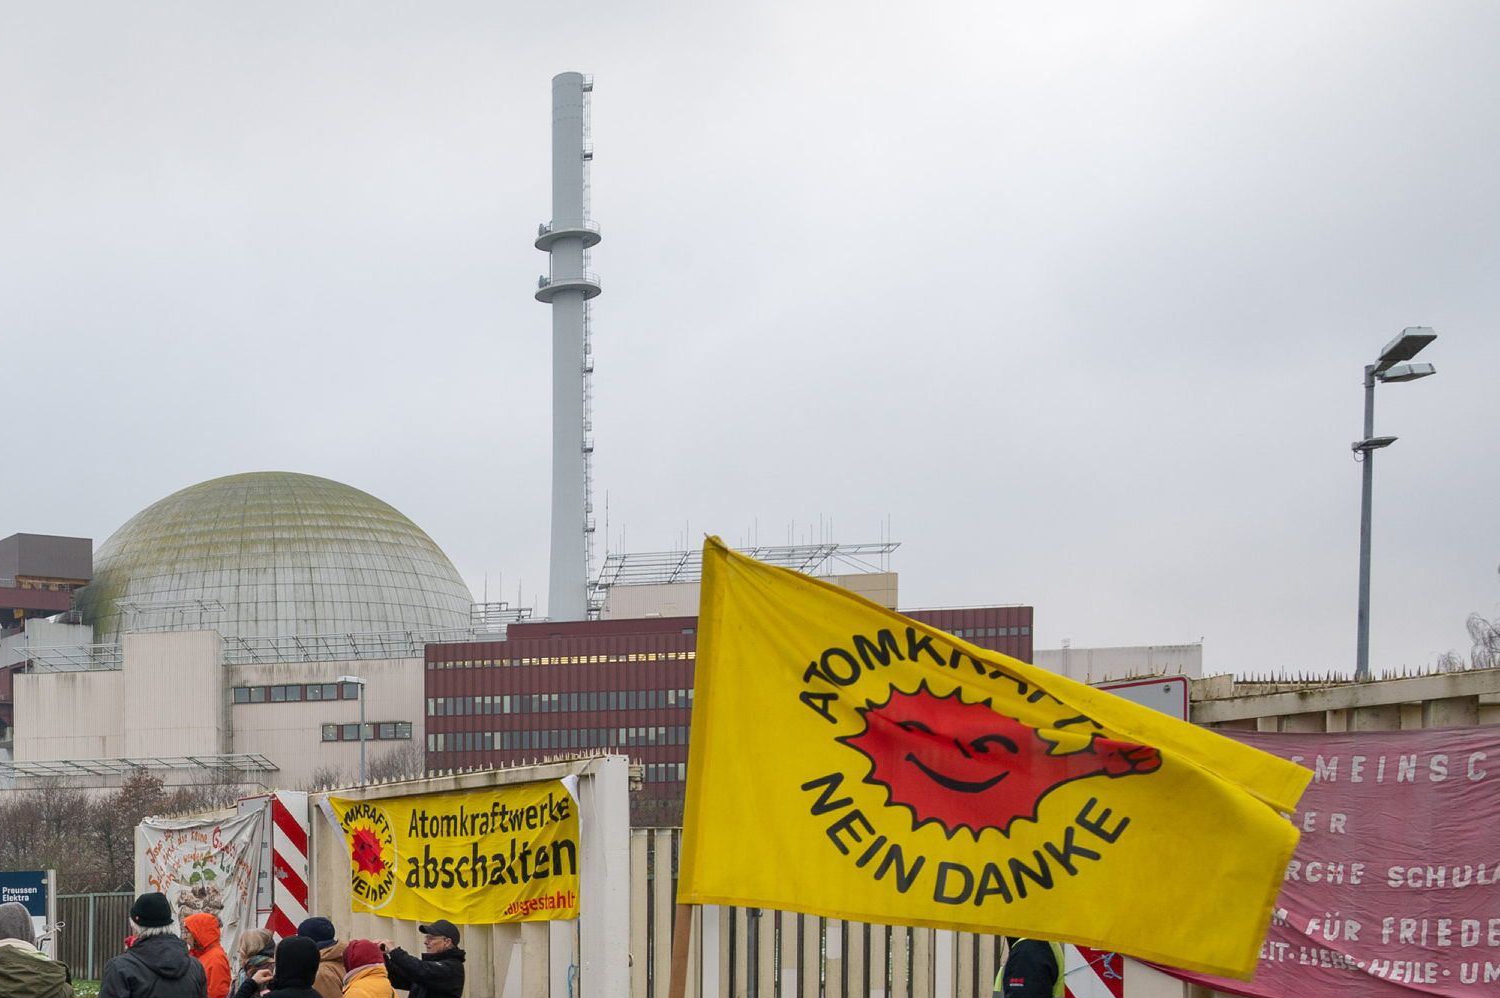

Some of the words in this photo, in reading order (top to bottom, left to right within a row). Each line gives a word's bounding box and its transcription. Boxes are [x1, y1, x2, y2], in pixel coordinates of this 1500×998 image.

[1291, 751, 1488, 784] MEINSC
[407, 792, 570, 838] Atomkraftwerke
[801, 771, 926, 894] NEIN
[933, 797, 1131, 906] DANKE
[405, 838, 576, 889] abschalten
[1305, 911, 1362, 941] FÜR
